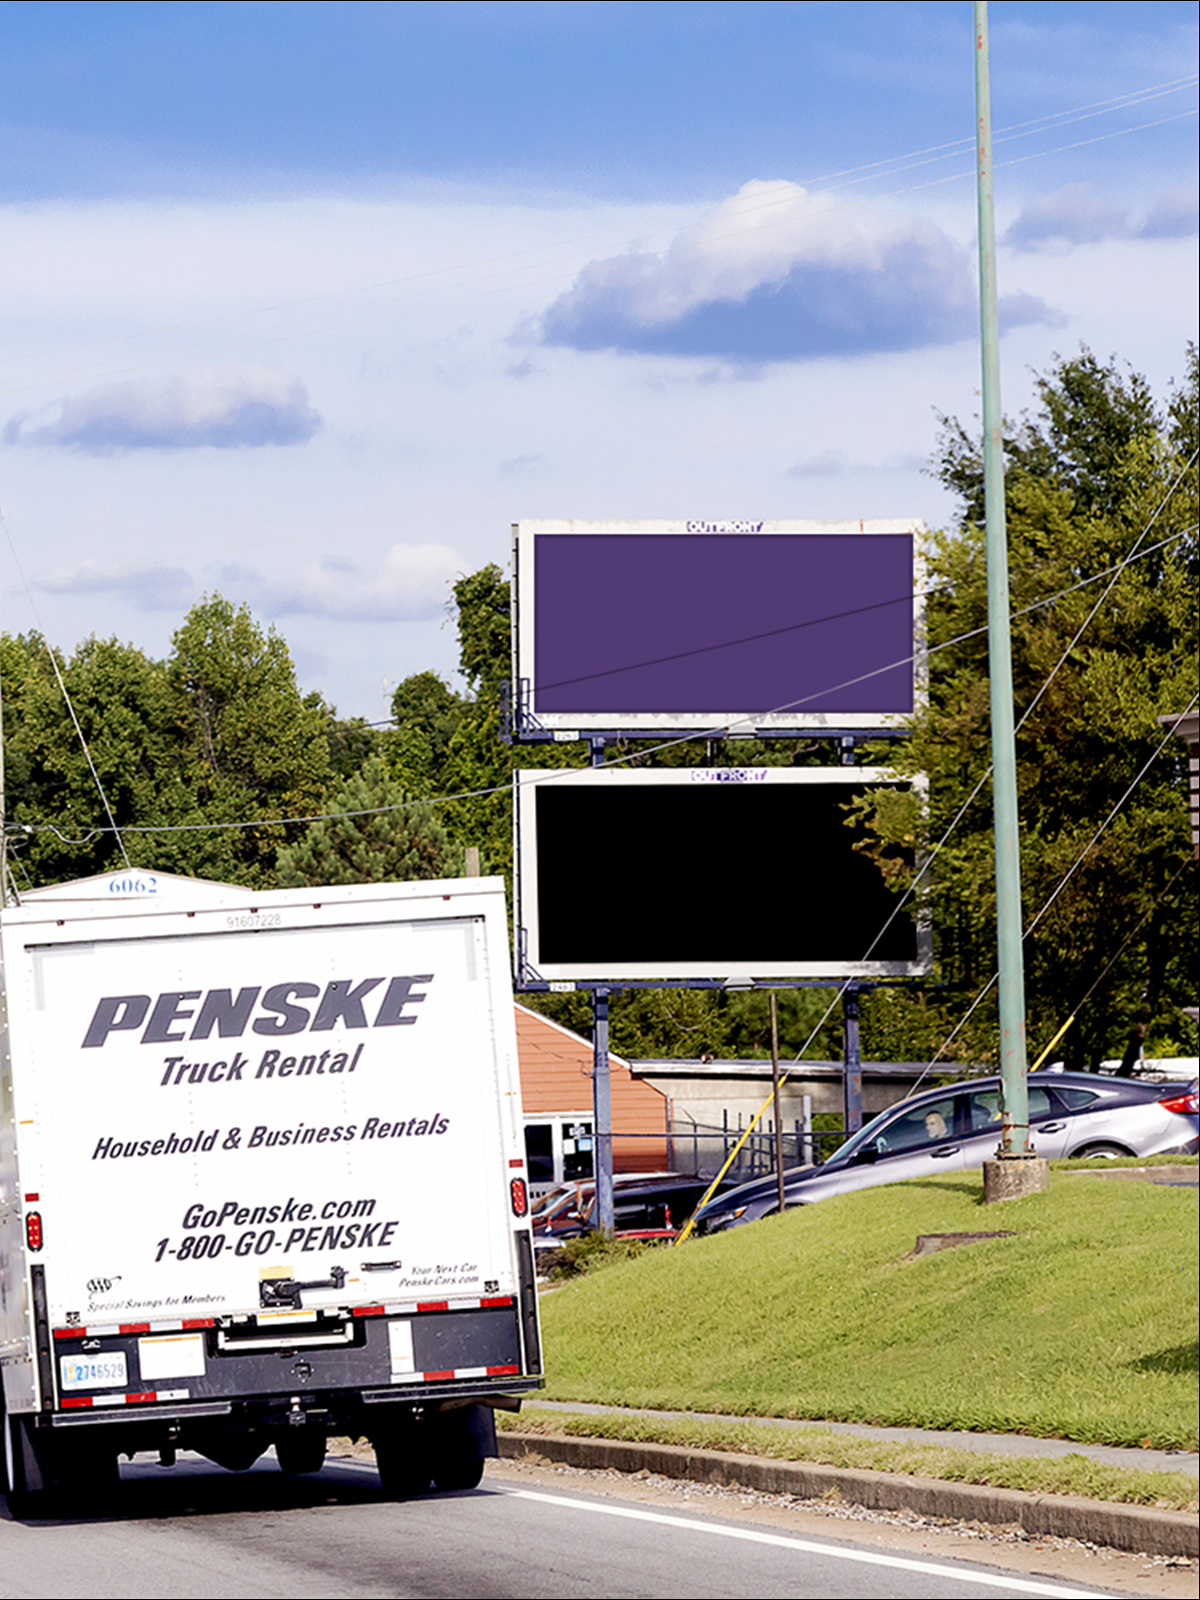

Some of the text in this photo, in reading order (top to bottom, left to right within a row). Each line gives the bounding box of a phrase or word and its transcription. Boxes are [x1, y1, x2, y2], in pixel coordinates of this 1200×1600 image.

[109, 877, 157, 894] 6062
[226, 914, 282, 928] 91607228
[81, 974, 435, 1049] PENSKE
[160, 1043, 365, 1086] Truck Rental
[91, 1112, 451, 1160] Household & Business Rentals
[182, 1197, 377, 1230] GoPenske.com
[154, 1220, 399, 1263] 1-800-GO-PENSKE
[411, 1262, 478, 1276] Your Next Car
[87, 1293, 227, 1313] Special Savings for Members
[76, 1362, 124, 1381] 2746529
